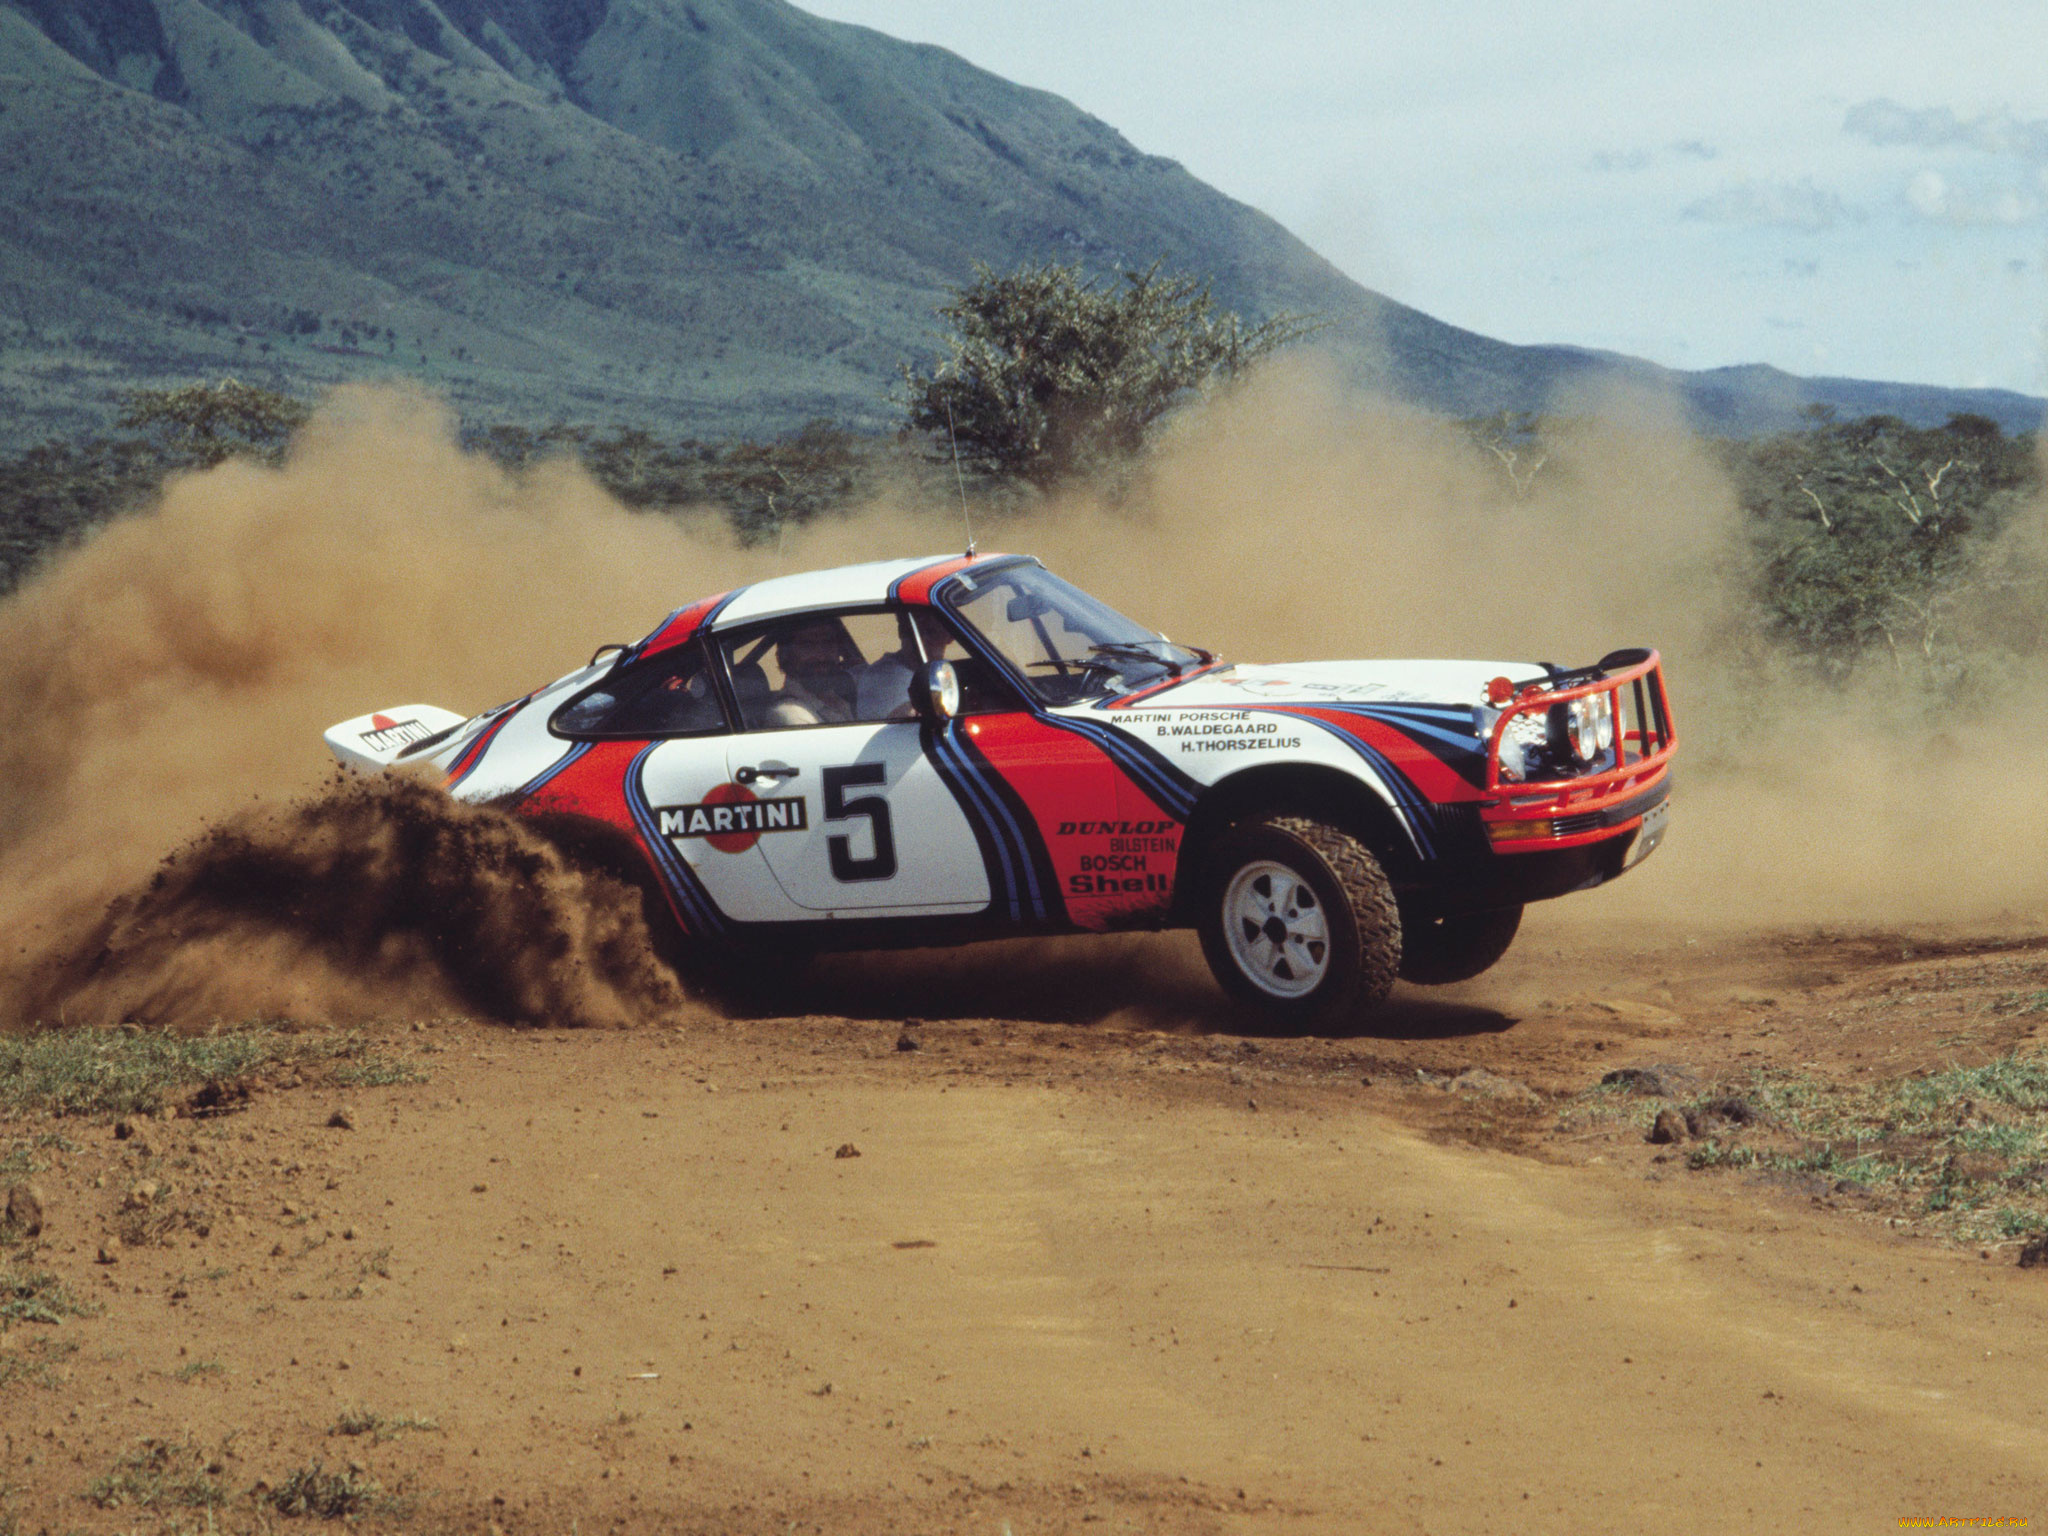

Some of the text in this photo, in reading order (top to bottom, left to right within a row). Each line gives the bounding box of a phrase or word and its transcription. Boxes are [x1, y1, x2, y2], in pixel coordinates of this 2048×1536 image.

[1111, 711, 1250, 724] MARTINI PORSCHE
[363, 720, 433, 752] MARTINI
[1157, 723, 1278, 736] B.WALDEGAARD
[1181, 737, 1301, 752] H.THORSZELIUS
[660, 801, 801, 836] MARTINI
[820, 760, 898, 884] 5
[1056, 821, 1176, 836] DUNLOP
[1110, 838, 1177, 853] BILSTEIN
[1080, 855, 1147, 872] BOSCH
[1069, 873, 1168, 893] Shell
